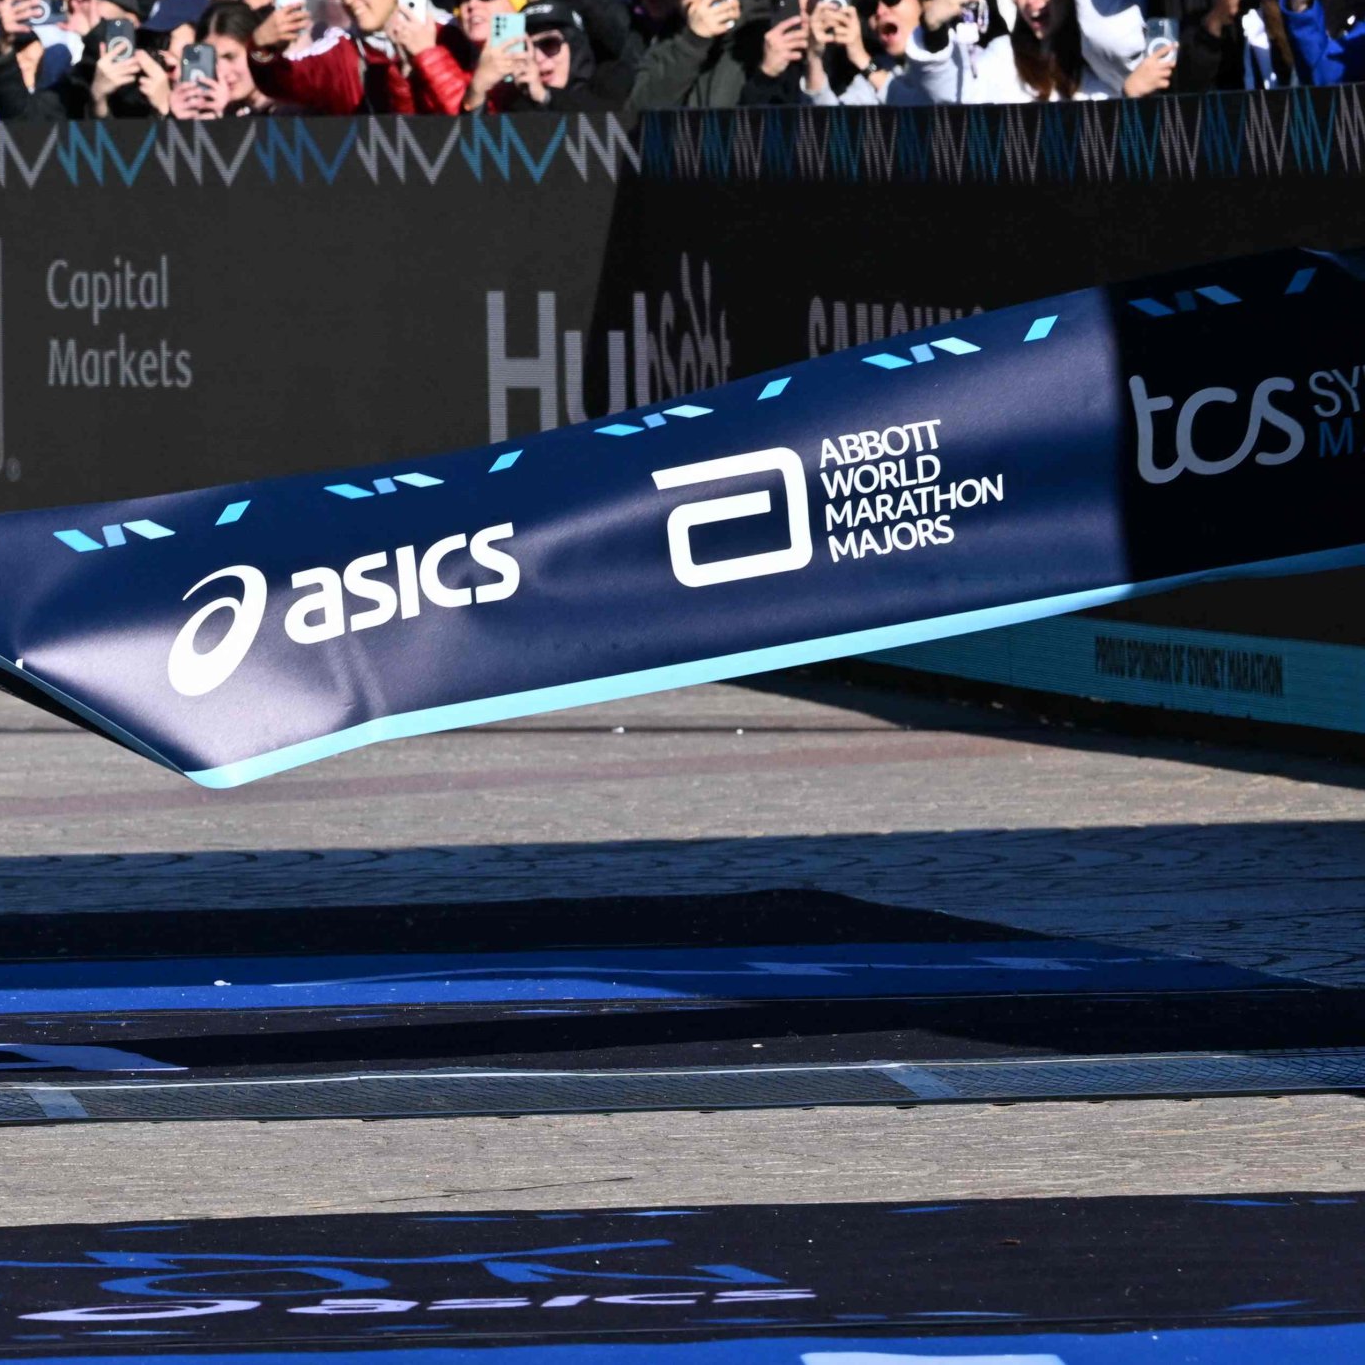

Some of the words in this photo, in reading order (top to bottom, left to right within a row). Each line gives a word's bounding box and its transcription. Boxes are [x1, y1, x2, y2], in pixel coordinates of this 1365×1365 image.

[46, 255, 169, 330] Capital
[47, 336, 193, 389] Markets
[1308, 365, 1365, 418] SY
[819, 419, 942, 469] ABBOTT
[821, 453, 942, 498] WORLD
[824, 474, 1005, 533] MARATHON
[827, 514, 955, 564] MAJORS
[284, 521, 521, 646] asics
